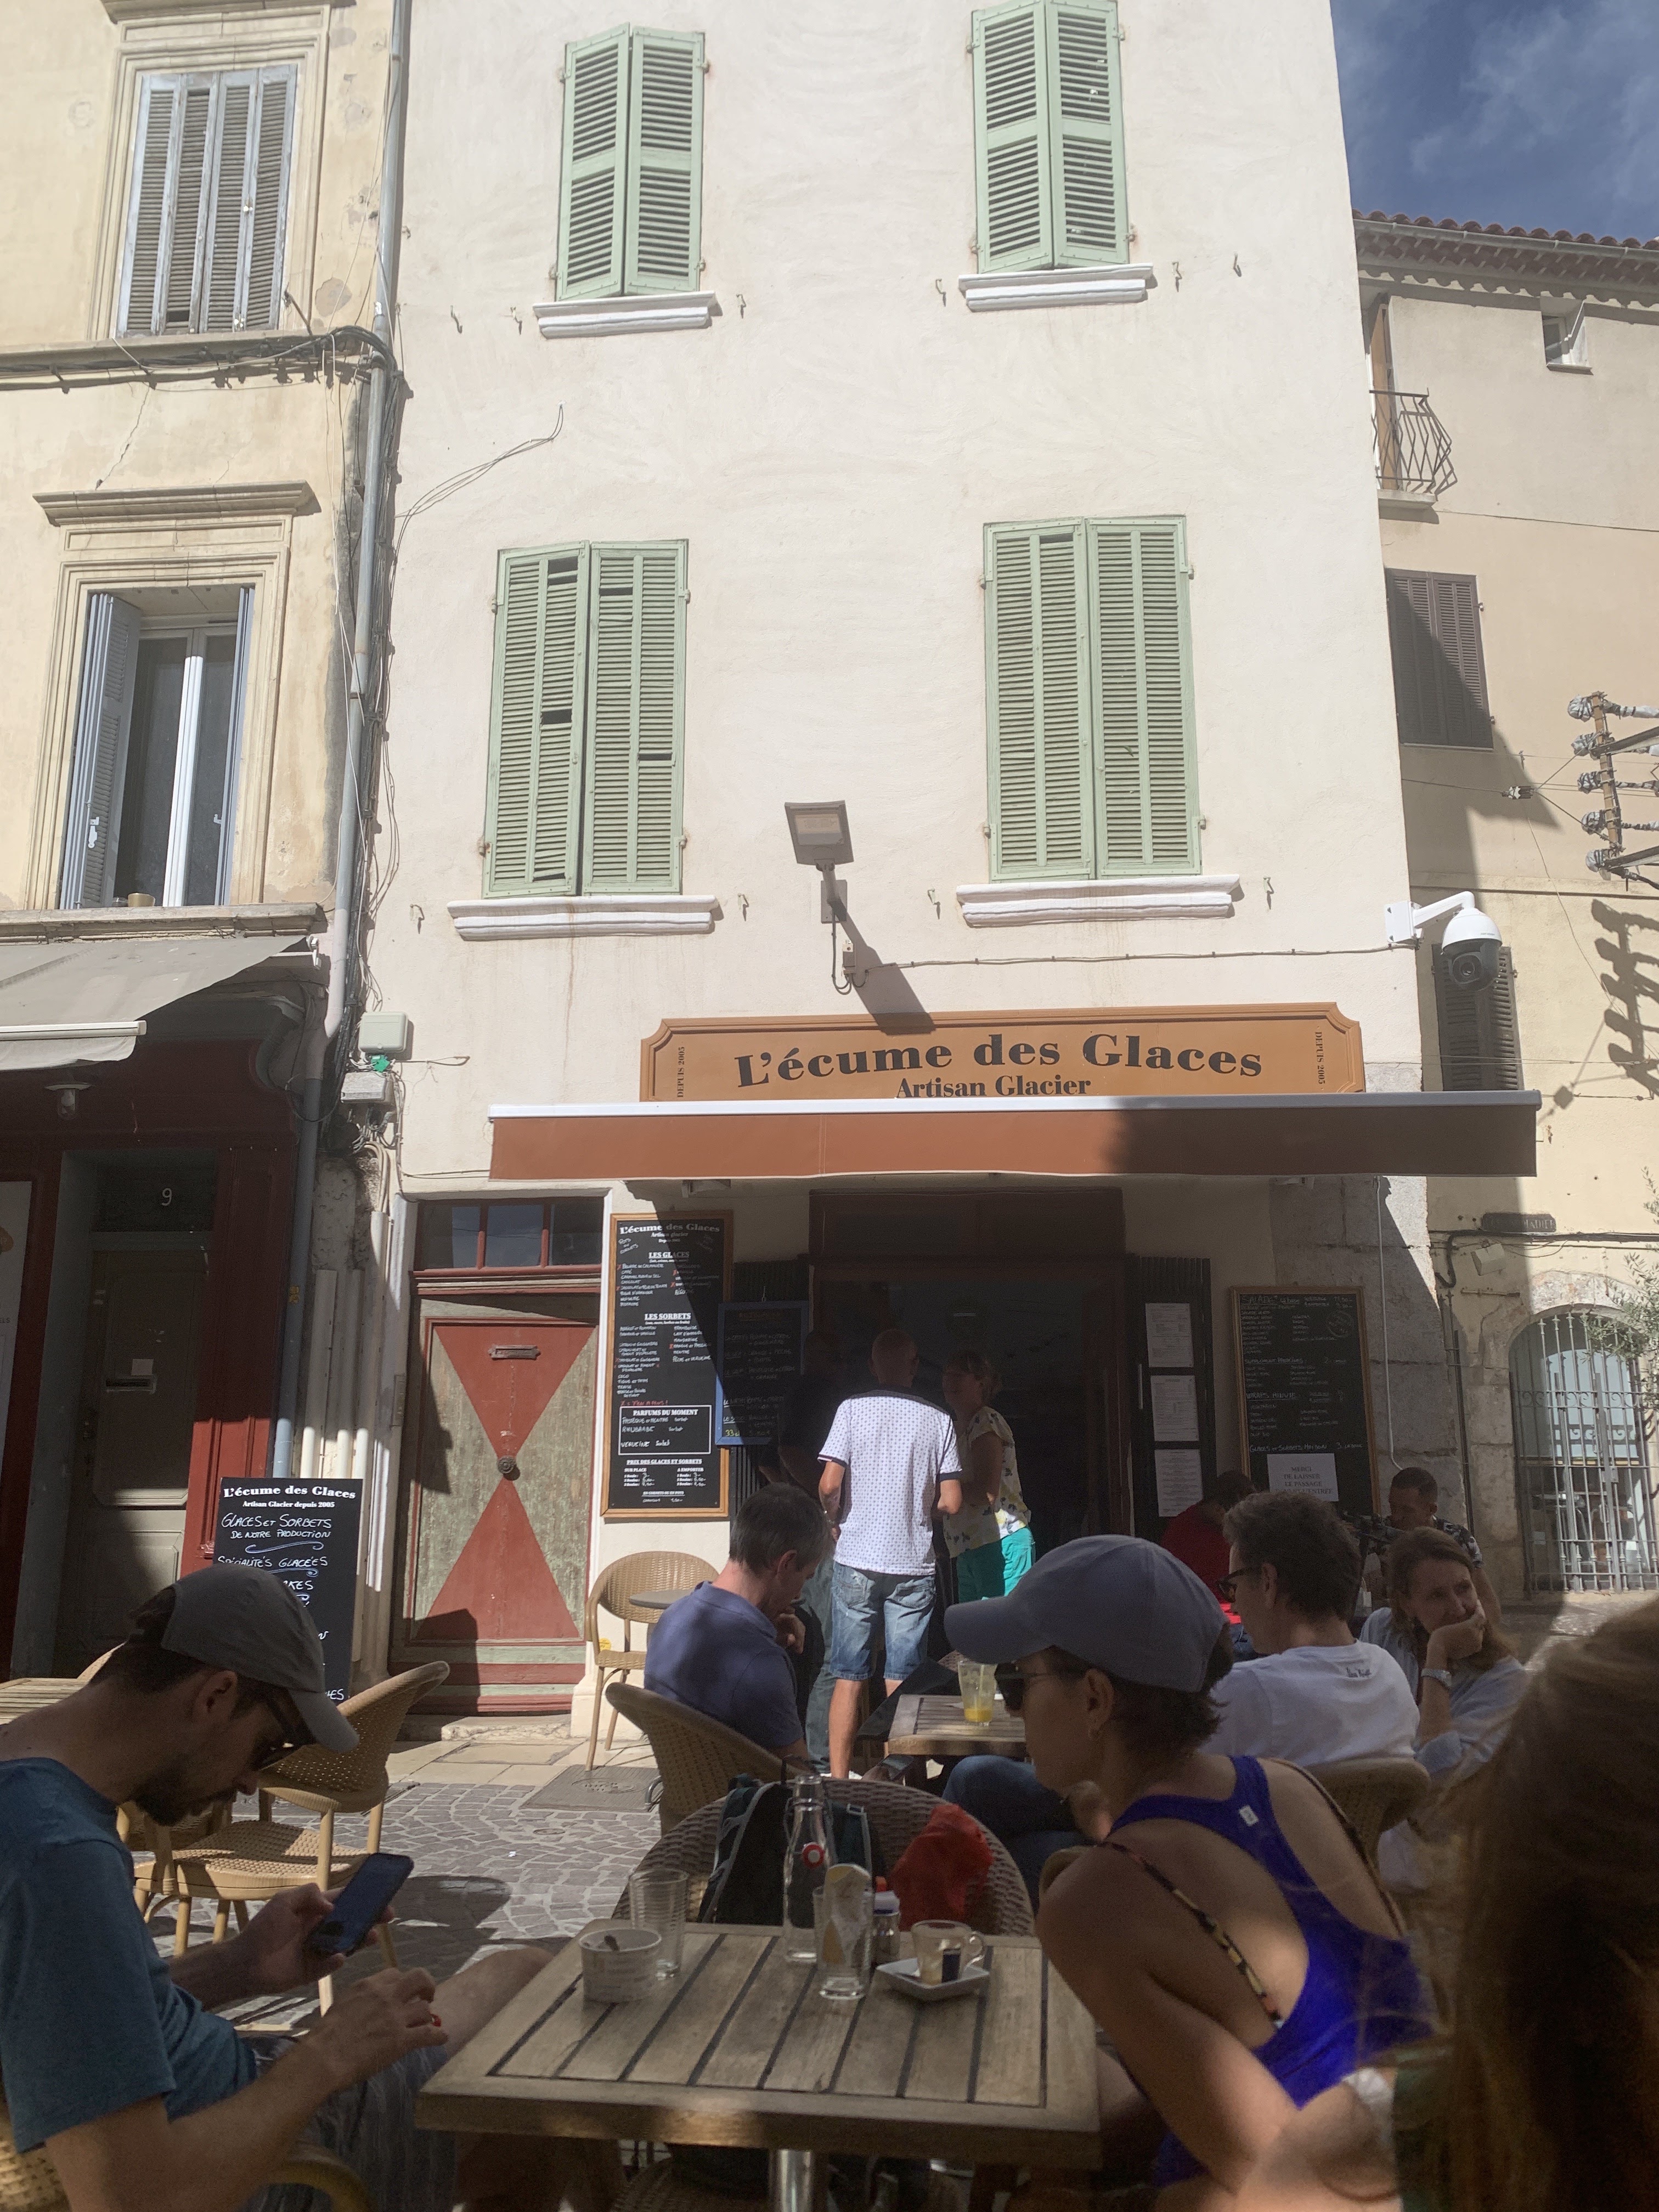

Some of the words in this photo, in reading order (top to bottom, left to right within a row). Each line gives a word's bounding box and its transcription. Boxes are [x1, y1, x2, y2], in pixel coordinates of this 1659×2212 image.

[1315, 1032, 1324, 1062] DEPUIS
[734, 1044, 953, 1087] L'écume
[974, 1034, 1060, 1066] des
[1082, 1033, 1262, 1077] Glaces
[896, 1078, 987, 1098] Artisan
[995, 1074, 1091, 1097] Glacier
[161, 1188, 173, 1206] 9
[620, 1224, 662, 1234] L'écume
[686, 1223, 720, 1232] Glaces
[223, 1487, 281, 1498] L'écume
[285, 1485, 308, 1495] des
[312, 1486, 356, 1499] Glaces
[221, 1513, 262, 1528] GLACES
[279, 1514, 332, 1528] SORBETS
[230, 1531, 242, 1539] DE
[245, 1530, 271, 1538] NOTRE
[278, 1556, 328, 1567] GLACÉES
